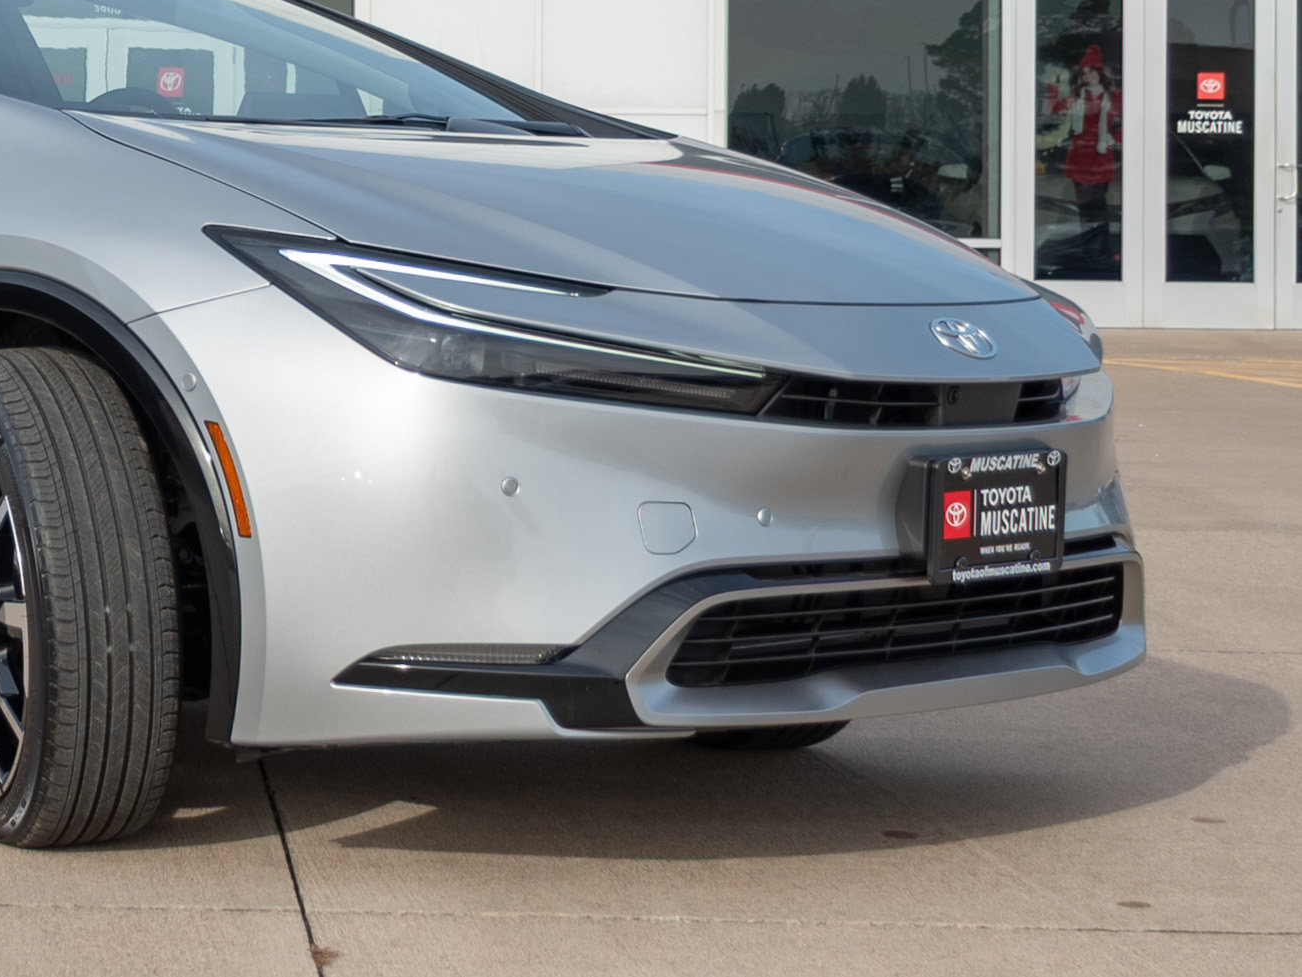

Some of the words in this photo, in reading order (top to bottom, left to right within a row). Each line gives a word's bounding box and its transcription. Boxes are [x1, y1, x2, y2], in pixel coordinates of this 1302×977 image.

[1188, 110, 1233, 120] TOYOTA
[1176, 120, 1243, 134] MUSCATINE
[970, 453, 1040, 473] MUSCATINE
[980, 485, 1032, 506] TOYOTA
[980, 505, 1056, 536] MUSCATINE
[952, 562, 1050, 583] toyotaofmuscatine.com
